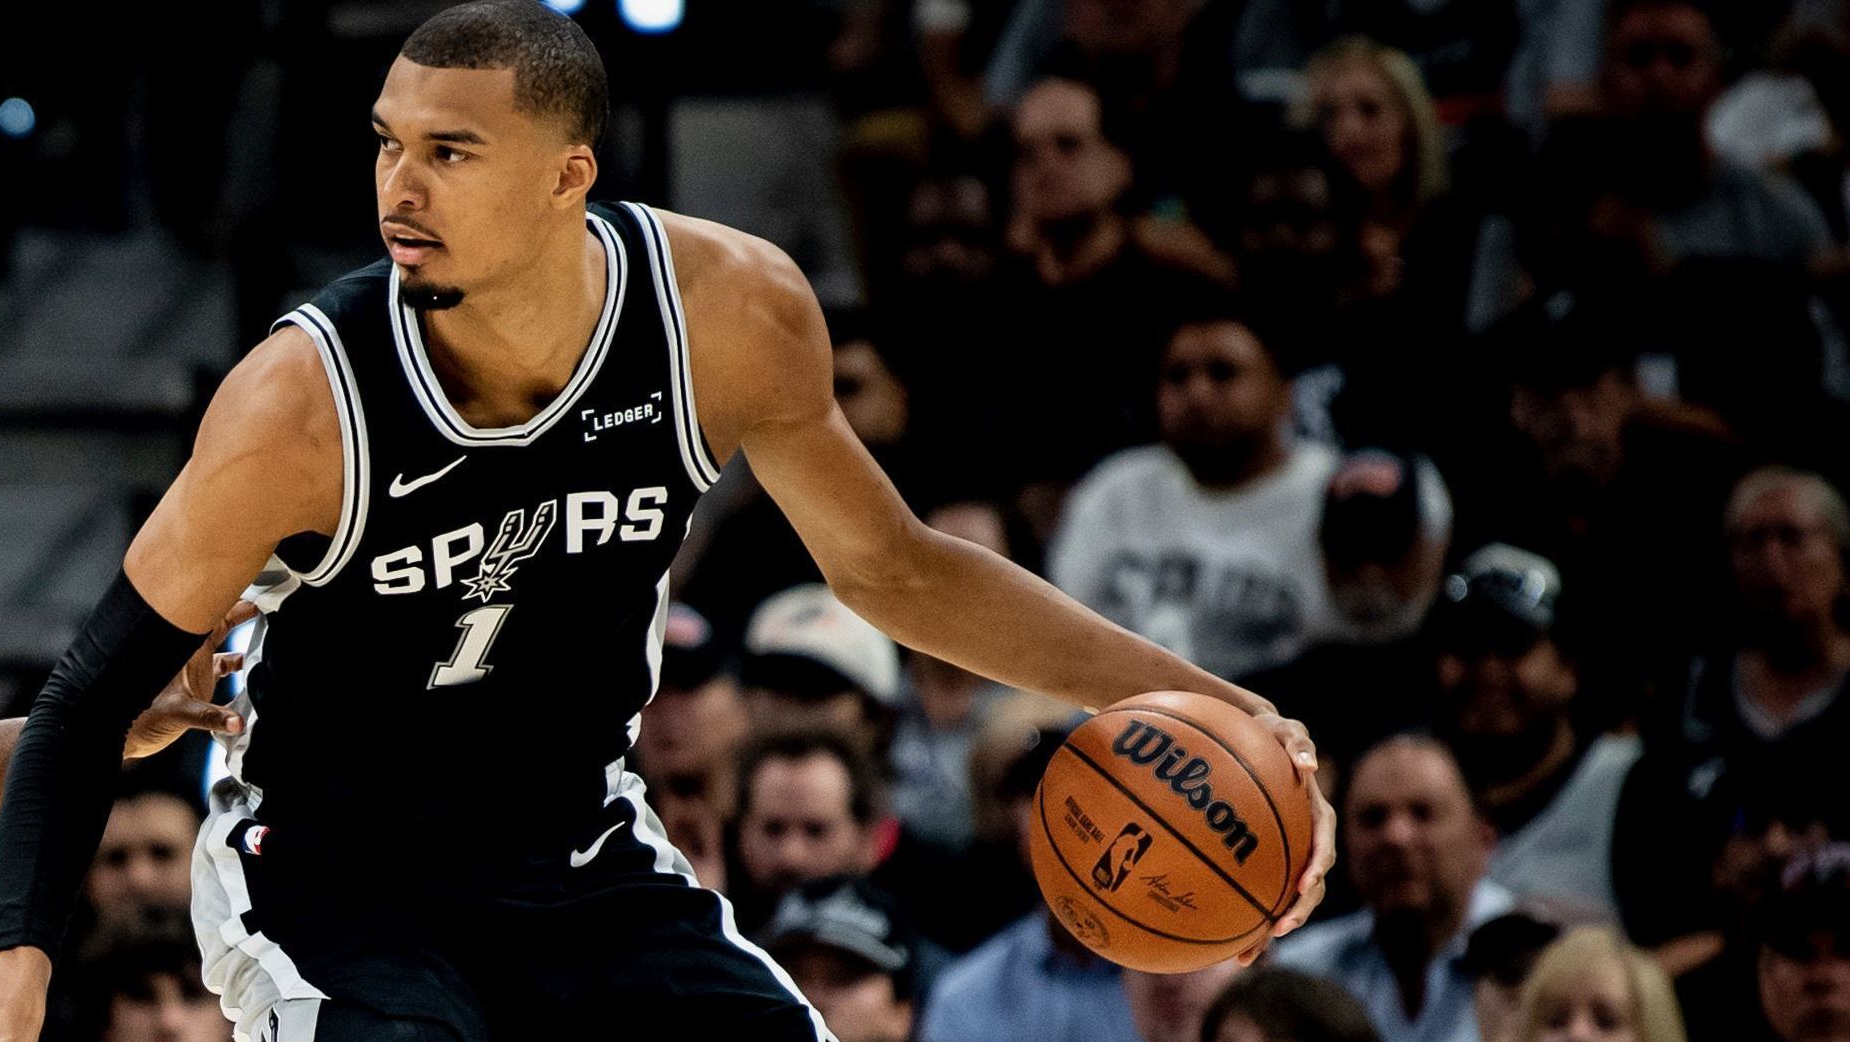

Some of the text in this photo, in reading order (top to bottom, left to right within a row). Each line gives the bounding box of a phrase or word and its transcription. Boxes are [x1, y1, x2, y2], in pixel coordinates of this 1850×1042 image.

[593, 402, 654, 431] LEDGER
[371, 486, 668, 603] SPURS
[426, 603, 515, 690] 1
[1111, 719, 1260, 867] Wilson
